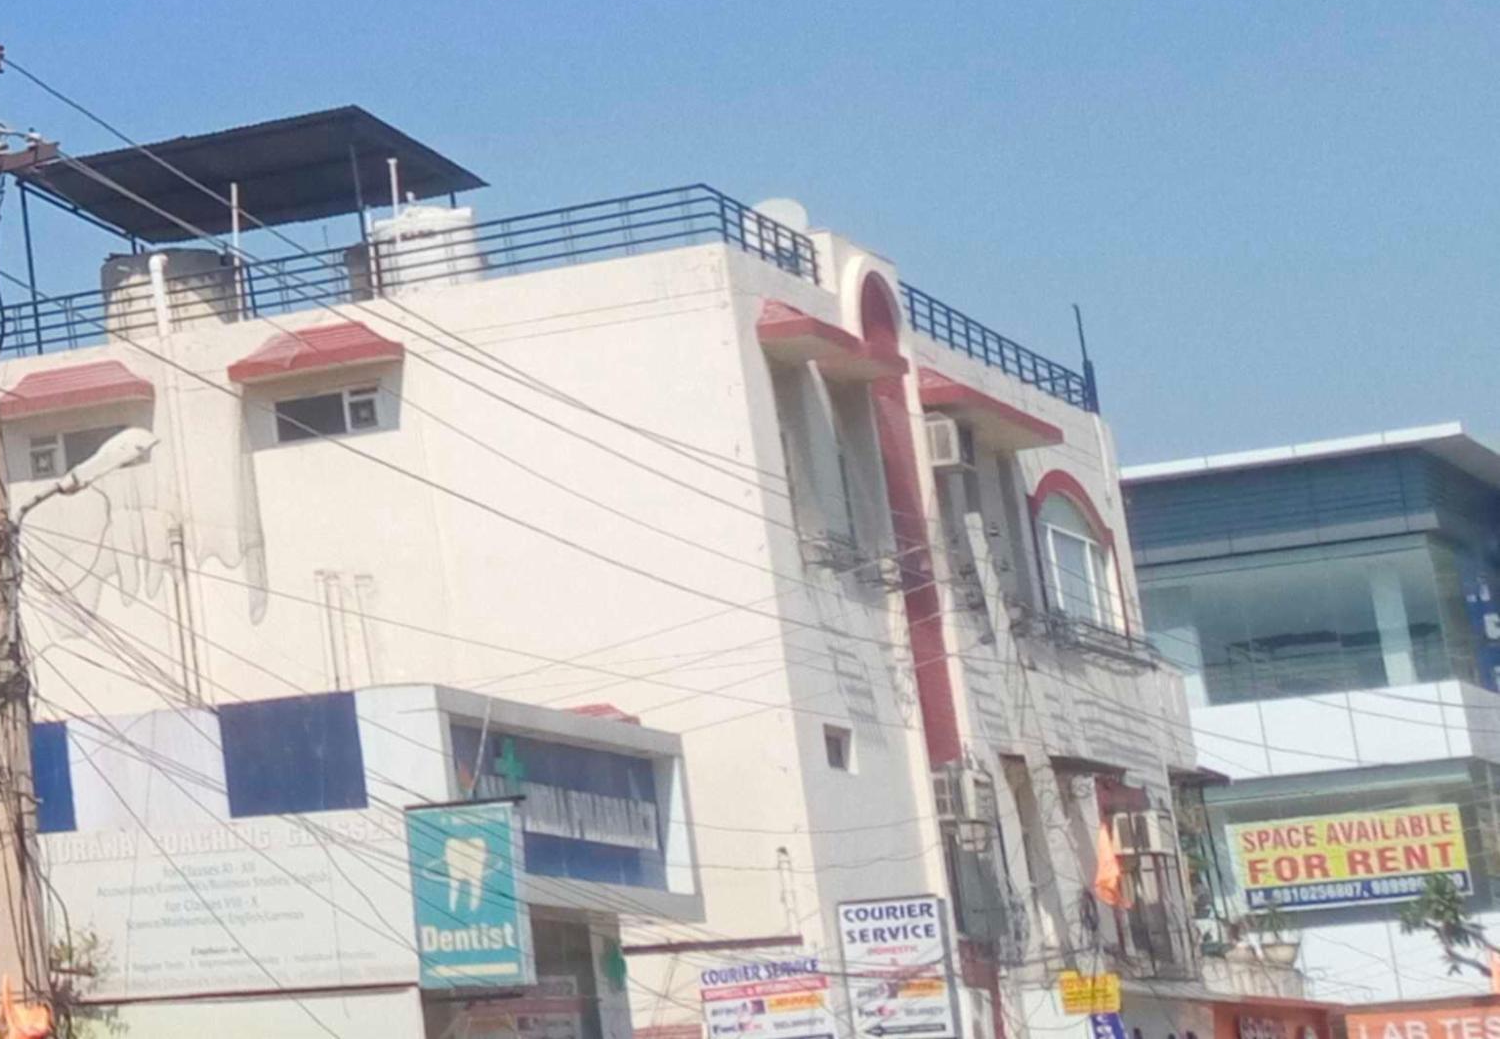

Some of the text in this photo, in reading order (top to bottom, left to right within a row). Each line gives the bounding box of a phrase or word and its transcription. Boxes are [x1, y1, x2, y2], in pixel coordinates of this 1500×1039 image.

[1242, 812, 1452, 854] SPACE AVAILABLE
[1247, 842, 1455, 885] FOR RENT
[843, 903, 934, 923] COURIER
[420, 924, 515, 952] Dentist
[846, 924, 937, 944] SERVICE
[701, 958, 819, 986] COURIER SERVICE
